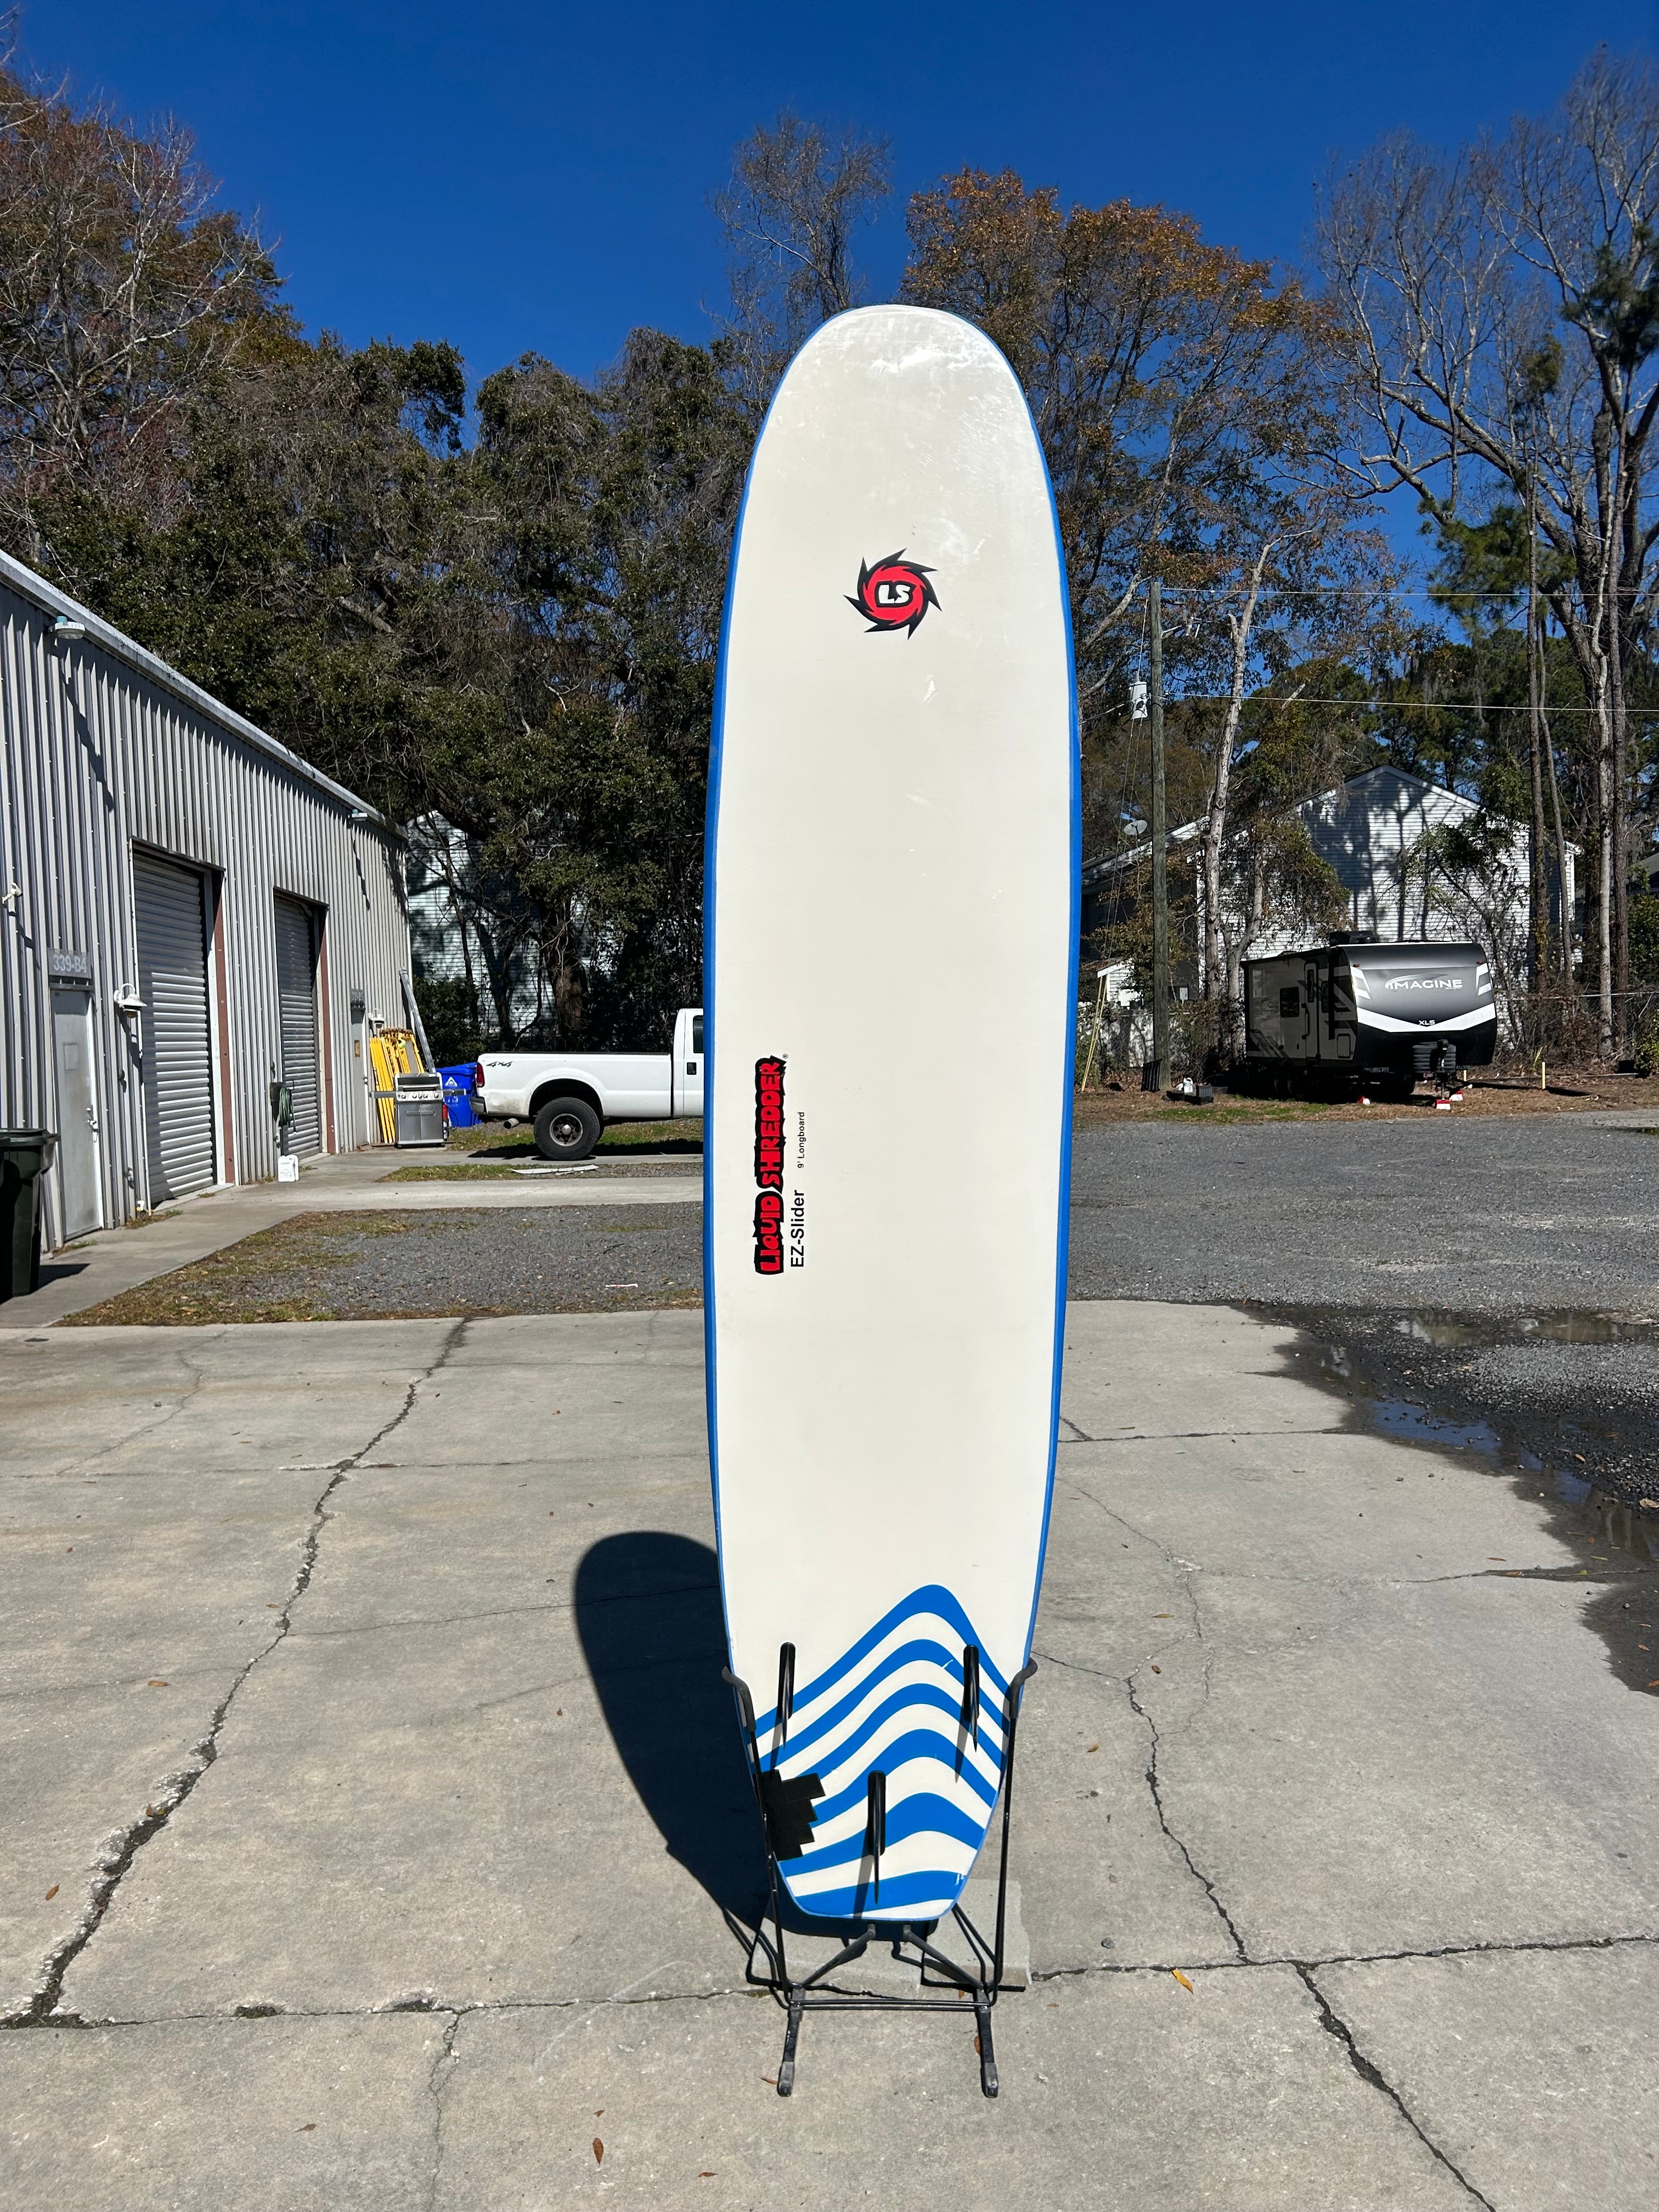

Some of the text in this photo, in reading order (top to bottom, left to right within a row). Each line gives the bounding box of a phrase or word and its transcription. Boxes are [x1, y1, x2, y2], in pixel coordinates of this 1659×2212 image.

[878, 584, 911, 604] LS
[53, 954, 87, 973] 339-B4
[1390, 979, 1463, 990] IMAGINE
[797, 1111, 806, 1159] Longboard
[759, 1061, 782, 1272] LIQUID SHREDDER
[791, 1189, 804, 1267] EZ-Slider
